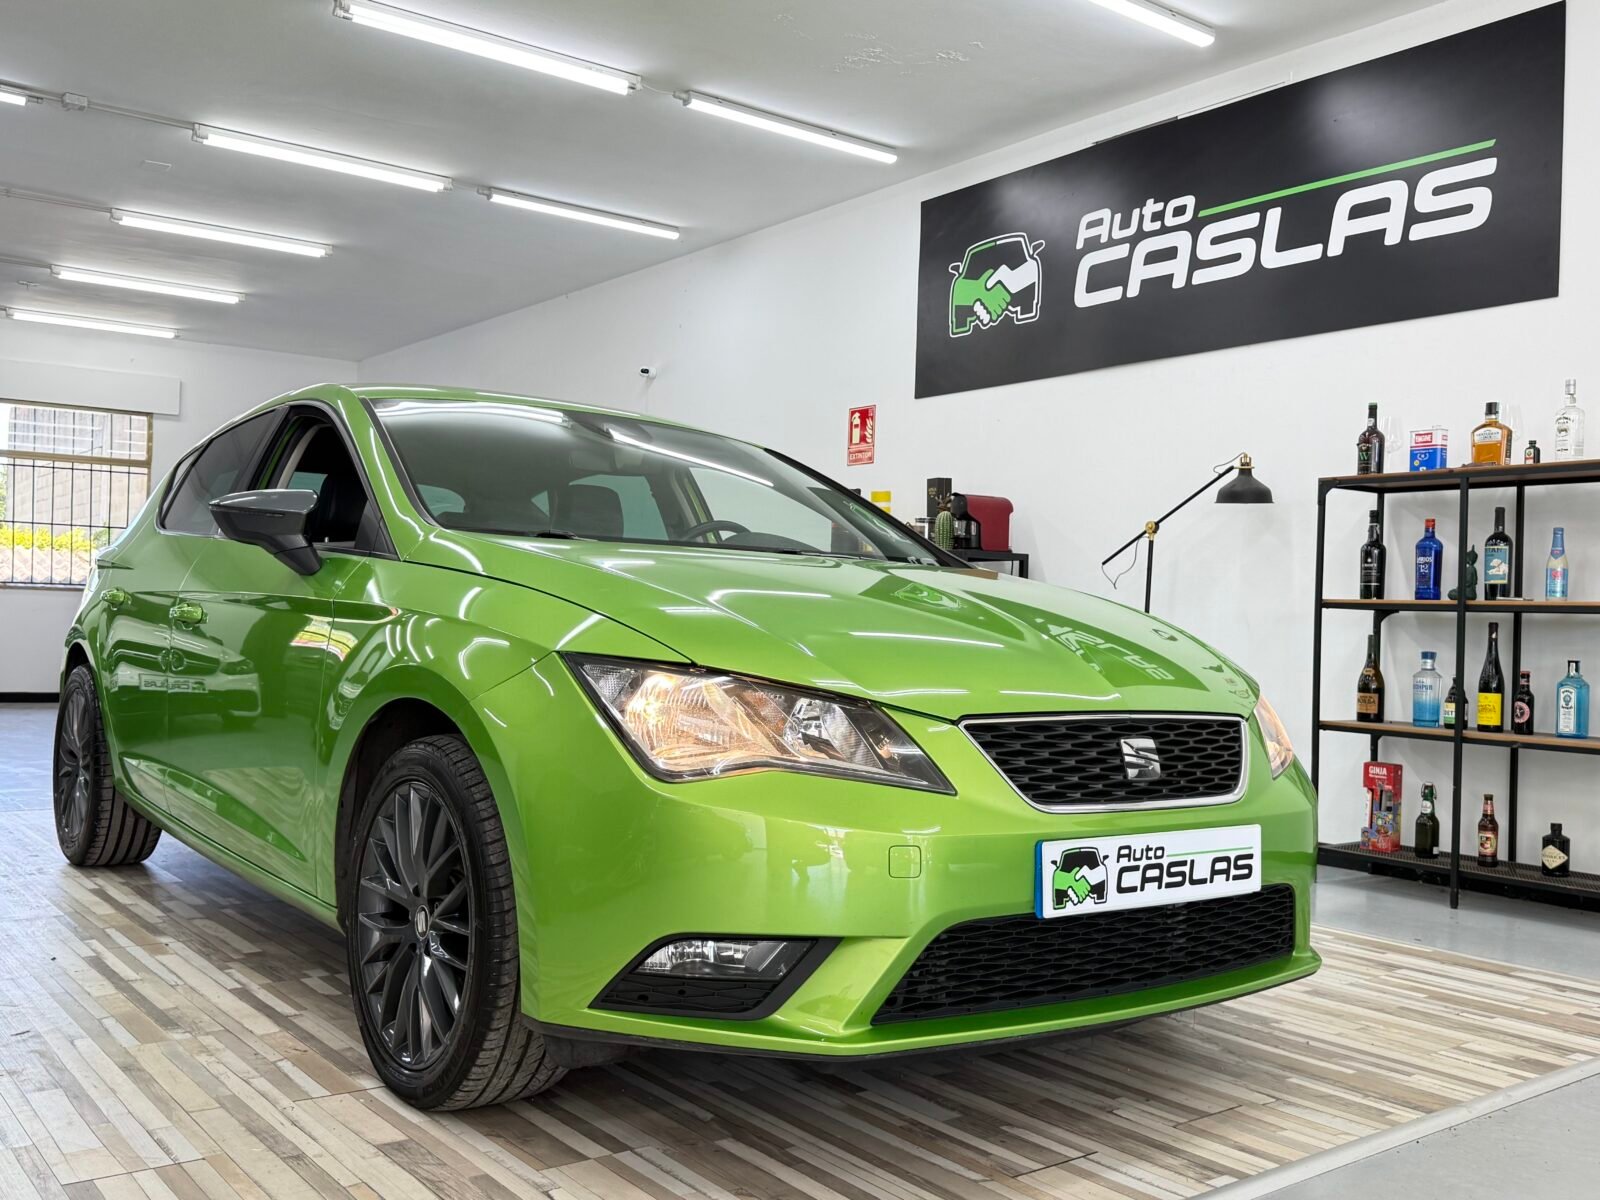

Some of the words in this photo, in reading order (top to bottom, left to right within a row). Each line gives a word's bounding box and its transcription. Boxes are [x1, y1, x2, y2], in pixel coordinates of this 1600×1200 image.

[1073, 157, 1498, 308] CASLAS
[1076, 195, 1196, 249] Auto
[849, 451, 873, 461] EXTINTOR
[1368, 765, 1388, 776] GINJA
[1116, 844, 1165, 863] Auto
[1116, 853, 1255, 894] CASLAS
